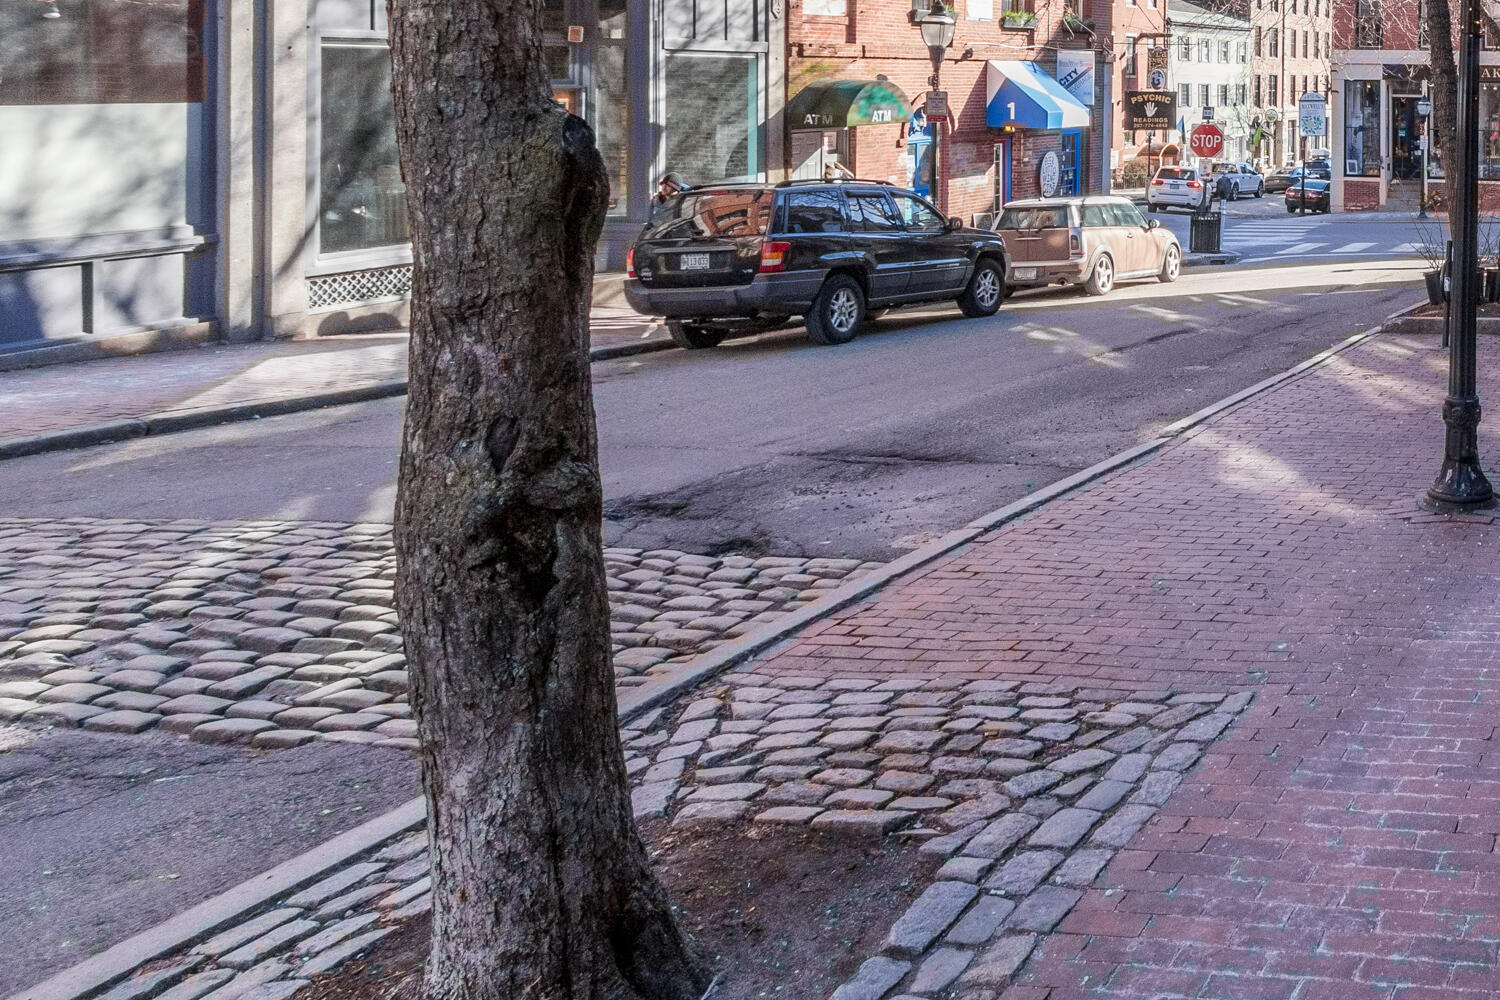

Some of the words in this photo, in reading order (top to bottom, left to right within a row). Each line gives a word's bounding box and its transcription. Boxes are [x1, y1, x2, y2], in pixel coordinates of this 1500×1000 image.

[1059, 68, 1079, 86] CITY
[1131, 93, 1172, 104] PSYCHIC
[872, 110, 892, 122] ATM
[1007, 102, 1016, 119] 1
[803, 113, 833, 125] ATM
[1192, 134, 1221, 148] STOP
